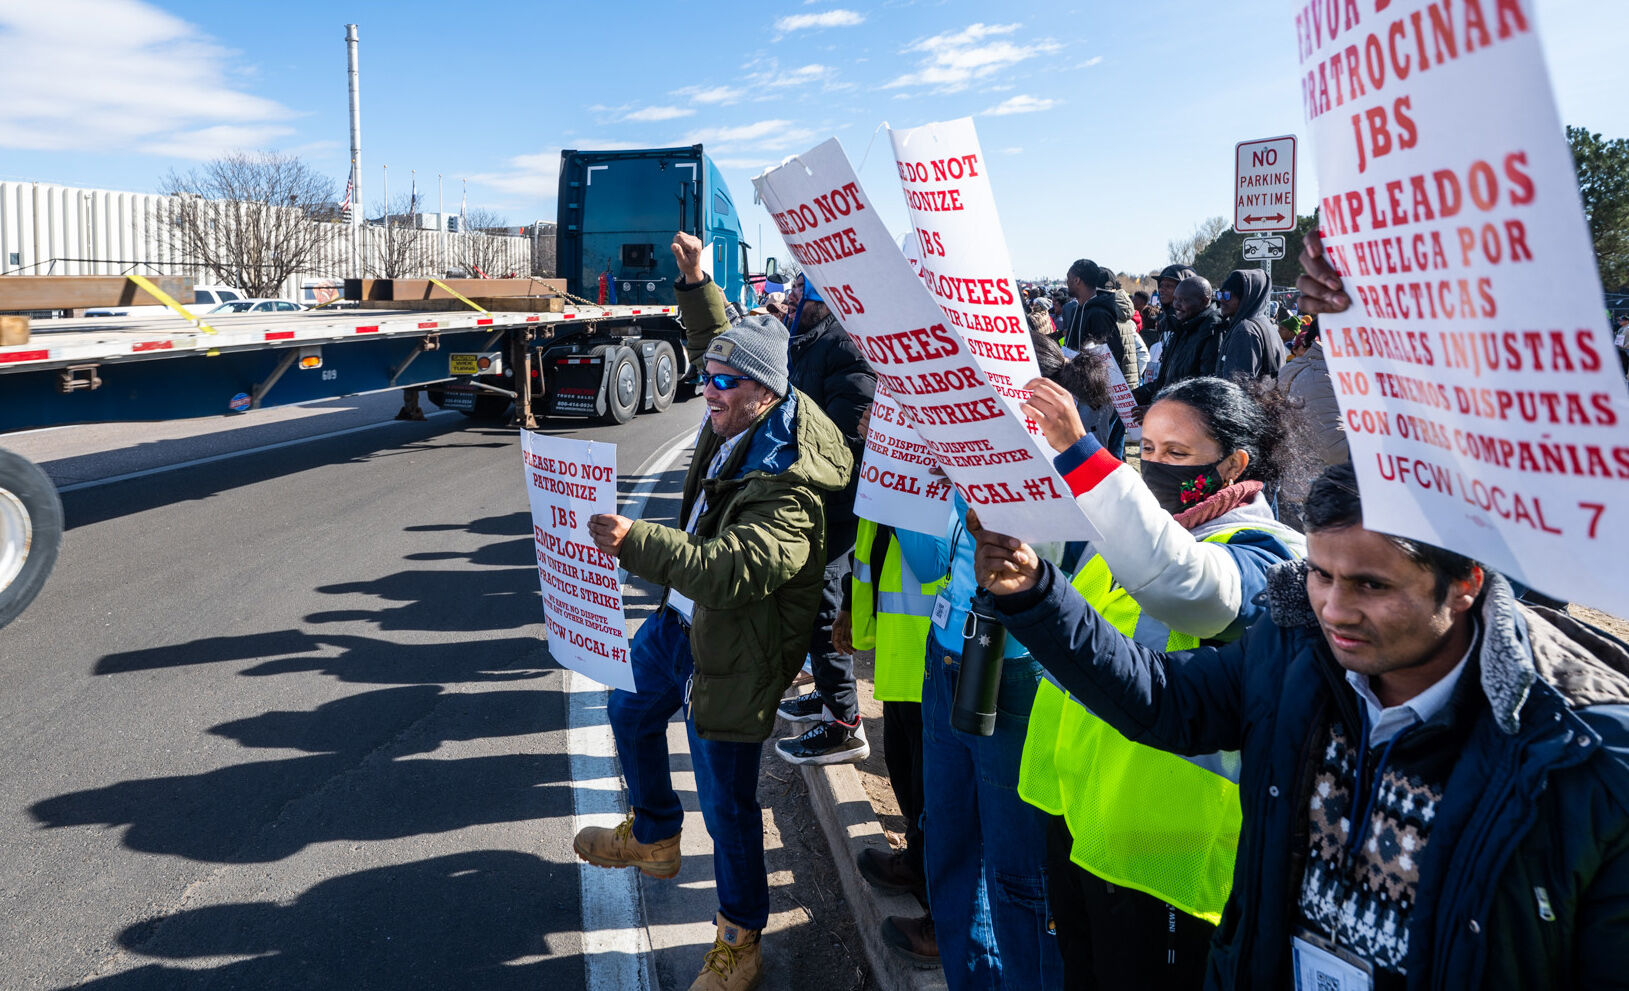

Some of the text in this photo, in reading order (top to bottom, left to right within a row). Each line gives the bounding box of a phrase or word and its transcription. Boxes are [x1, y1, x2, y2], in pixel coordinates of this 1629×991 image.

[1351, 95, 1417, 174] JBS
[905, 162, 928, 183] DO
[930, 154, 978, 182] NOT
[1252, 148, 1278, 168] NO
[1240, 171, 1290, 188] PARKING
[786, 204, 818, 233] DO
[813, 181, 865, 223] NOT
[904, 188, 964, 212] RONIZE
[1238, 191, 1291, 207] ANYTIME
[1318, 151, 1537, 239] MPLEADOS
[1353, 230, 1448, 277] HUELGA
[1457, 219, 1534, 268] POR
[1356, 277, 1498, 320] PRACTICAS
[963, 312, 1024, 334] LABOR
[968, 338, 1030, 362] STRIKE
[1325, 327, 1602, 378] LABORALES INJUSTAS
[905, 366, 985, 395] LABOR
[984, 371, 1012, 386] PUTE
[992, 384, 1033, 400] PLOYE
[921, 397, 1005, 425] STRIKE
[1337, 371, 1618, 427] NO TENEMOS DISPUTAS
[874, 429, 886, 443] NO
[888, 436, 933, 456] DISPUT
[938, 439, 994, 453] DISPUTE
[1346, 408, 1629, 480] CON OTRAS COMPAÑIAS
[523, 449, 613, 482] PLEASE DO NOT
[891, 448, 940, 469] EMPLOY
[953, 448, 1034, 467] EMPLOYER
[533, 472, 597, 502] PATRONIZE
[860, 461, 951, 501] LOCAL #7
[954, 476, 1062, 505] OCAL #7
[1376, 452, 1606, 540] UFCW LOCAL 7
[550, 505, 577, 530] JBS
[534, 524, 615, 572] EMPLOYEES
[547, 555, 579, 580] UNFAIR
[581, 569, 619, 592] LABOR
[539, 567, 620, 611] PRACTICE STRIKE
[563, 610, 584, 625] OTHER
[585, 618, 623, 638] EMPLOYER
[570, 605, 580, 615] NO
[580, 608, 609, 625] DISPUTE
[568, 629, 609, 658] LOCAL
[611, 646, 627, 663] #7
